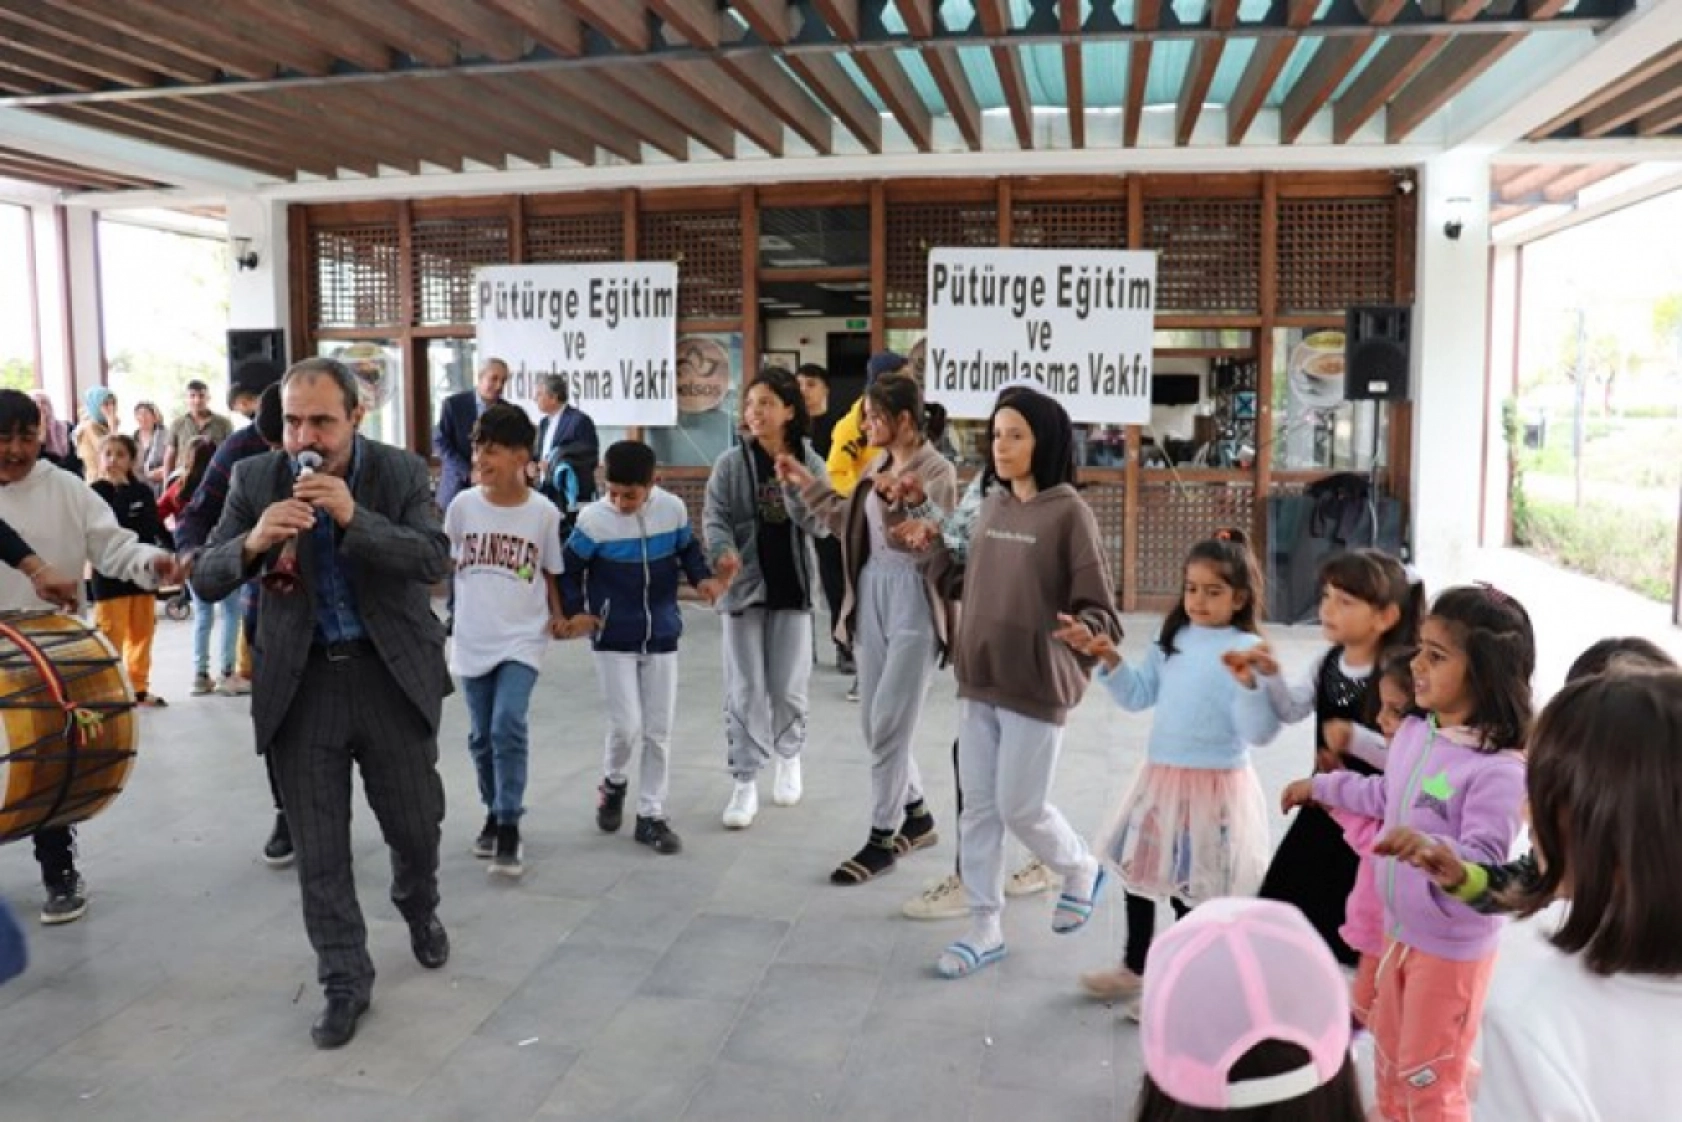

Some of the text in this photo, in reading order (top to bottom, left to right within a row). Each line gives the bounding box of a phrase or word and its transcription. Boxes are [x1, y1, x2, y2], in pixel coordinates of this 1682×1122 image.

[479, 276, 674, 330] Pütürge Eğitim
[932, 264, 1150, 319] Pütürge Eğitim
[563, 330, 586, 361] ve
[1026, 320, 1052, 350] ve
[619, 358, 673, 400] Vakfı
[1088, 352, 1147, 396] Vakfı
